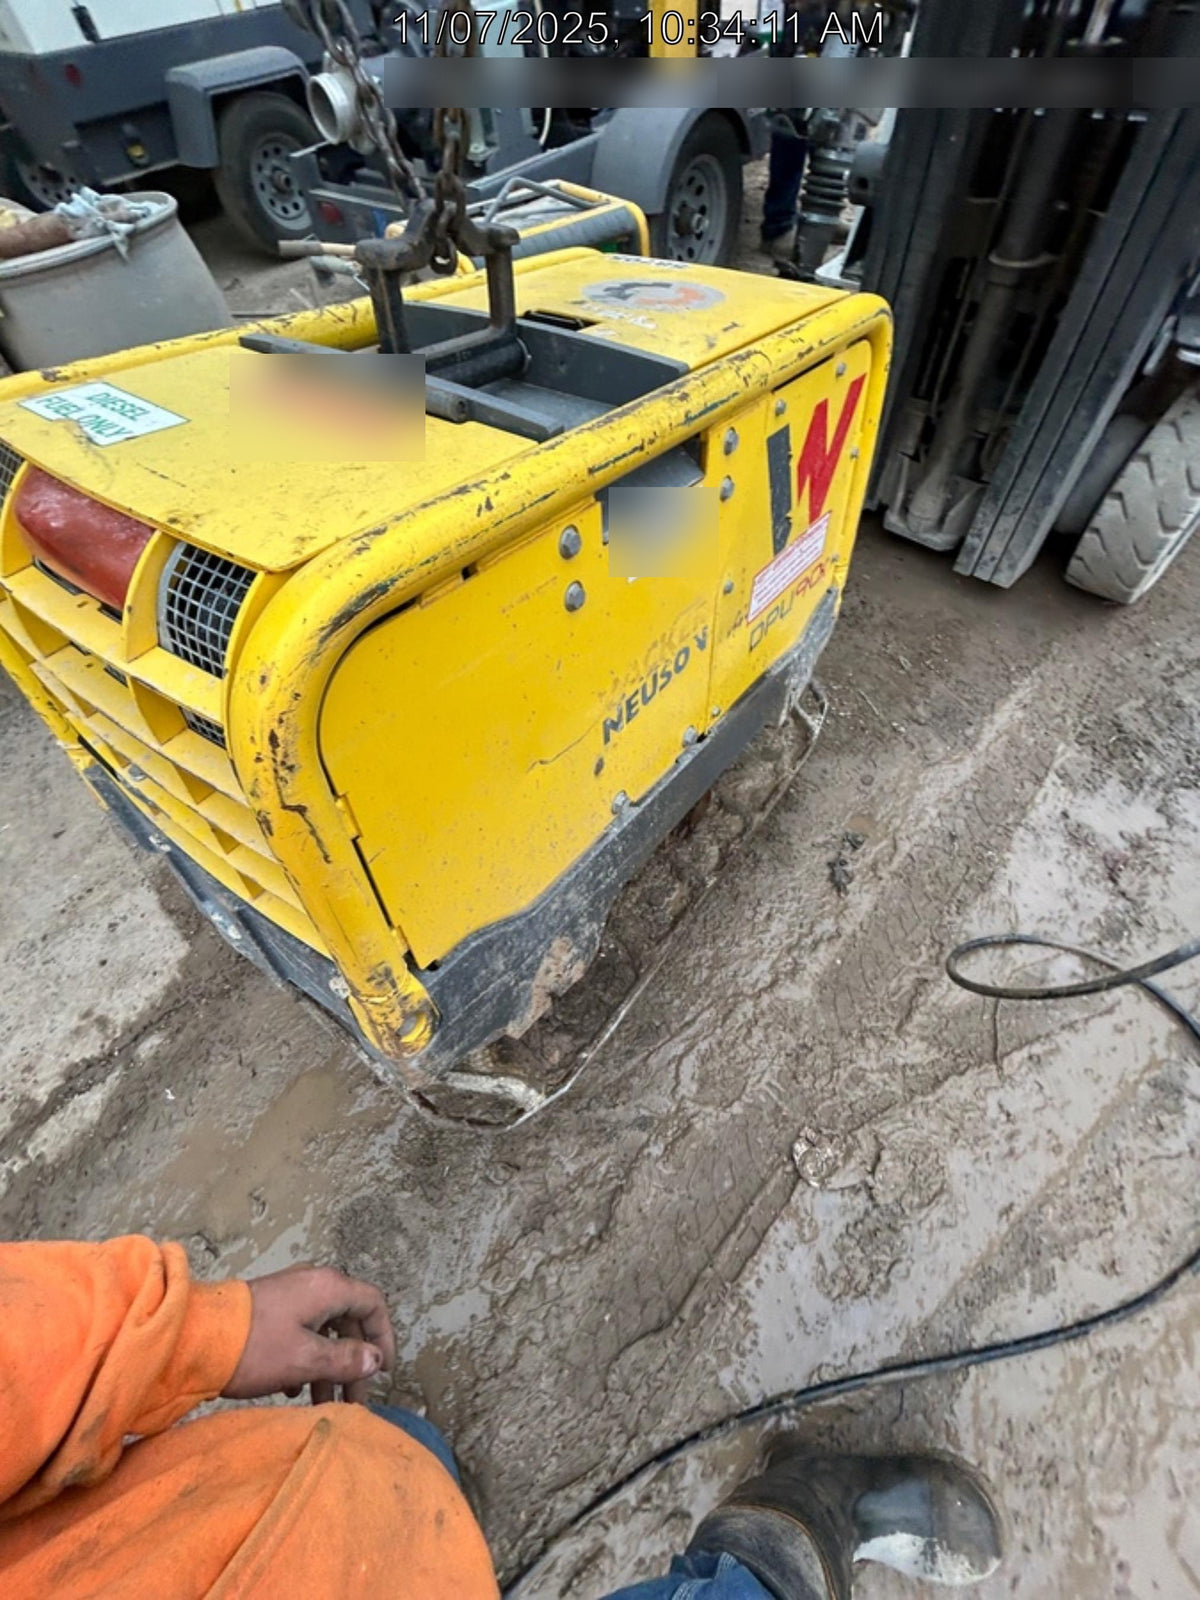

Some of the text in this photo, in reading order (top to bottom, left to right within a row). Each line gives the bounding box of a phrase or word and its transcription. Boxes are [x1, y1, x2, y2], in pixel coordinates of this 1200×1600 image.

[35, 395, 134, 438] FUEL ONLY
[86, 391, 152, 422] DIESEL
